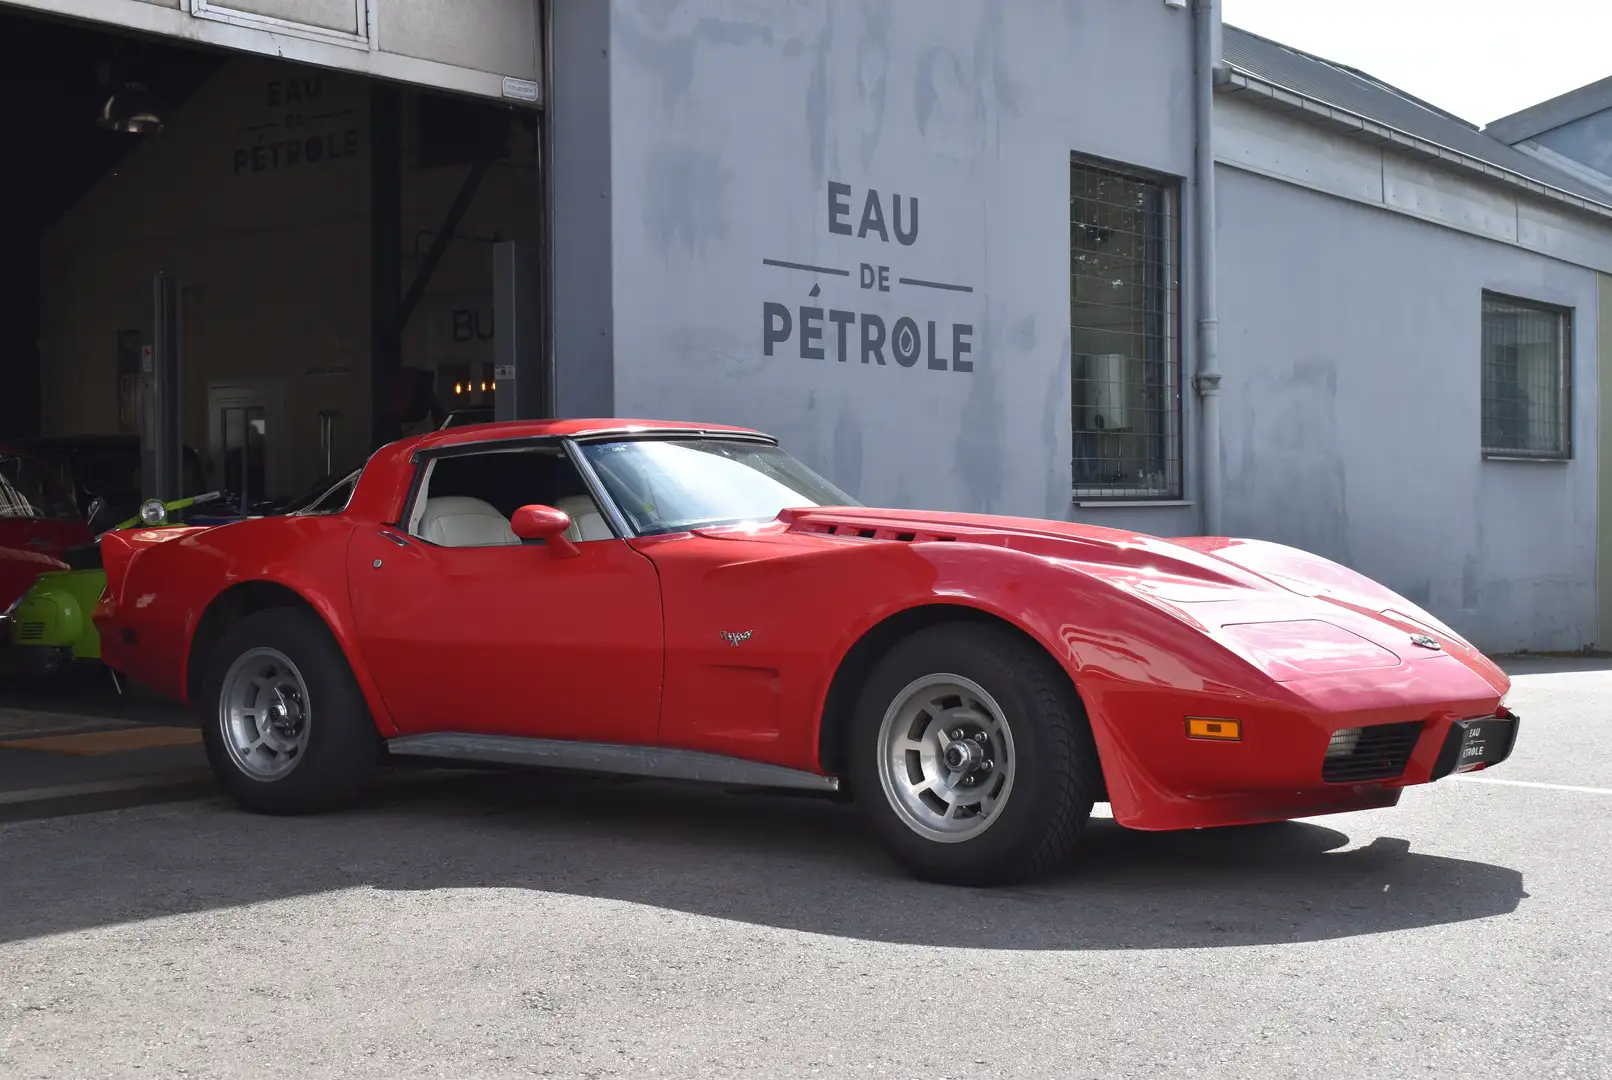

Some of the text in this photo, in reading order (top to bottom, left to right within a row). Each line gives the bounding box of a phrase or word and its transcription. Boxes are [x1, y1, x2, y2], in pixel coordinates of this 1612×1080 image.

[267, 72, 323, 107] EAU
[233, 134, 359, 175] PÉTROLE
[827, 180, 919, 247] EAU
[859, 262, 891, 293] DE
[763, 283, 974, 373] PÉTROLE
[1469, 727, 1481, 738] EAU
